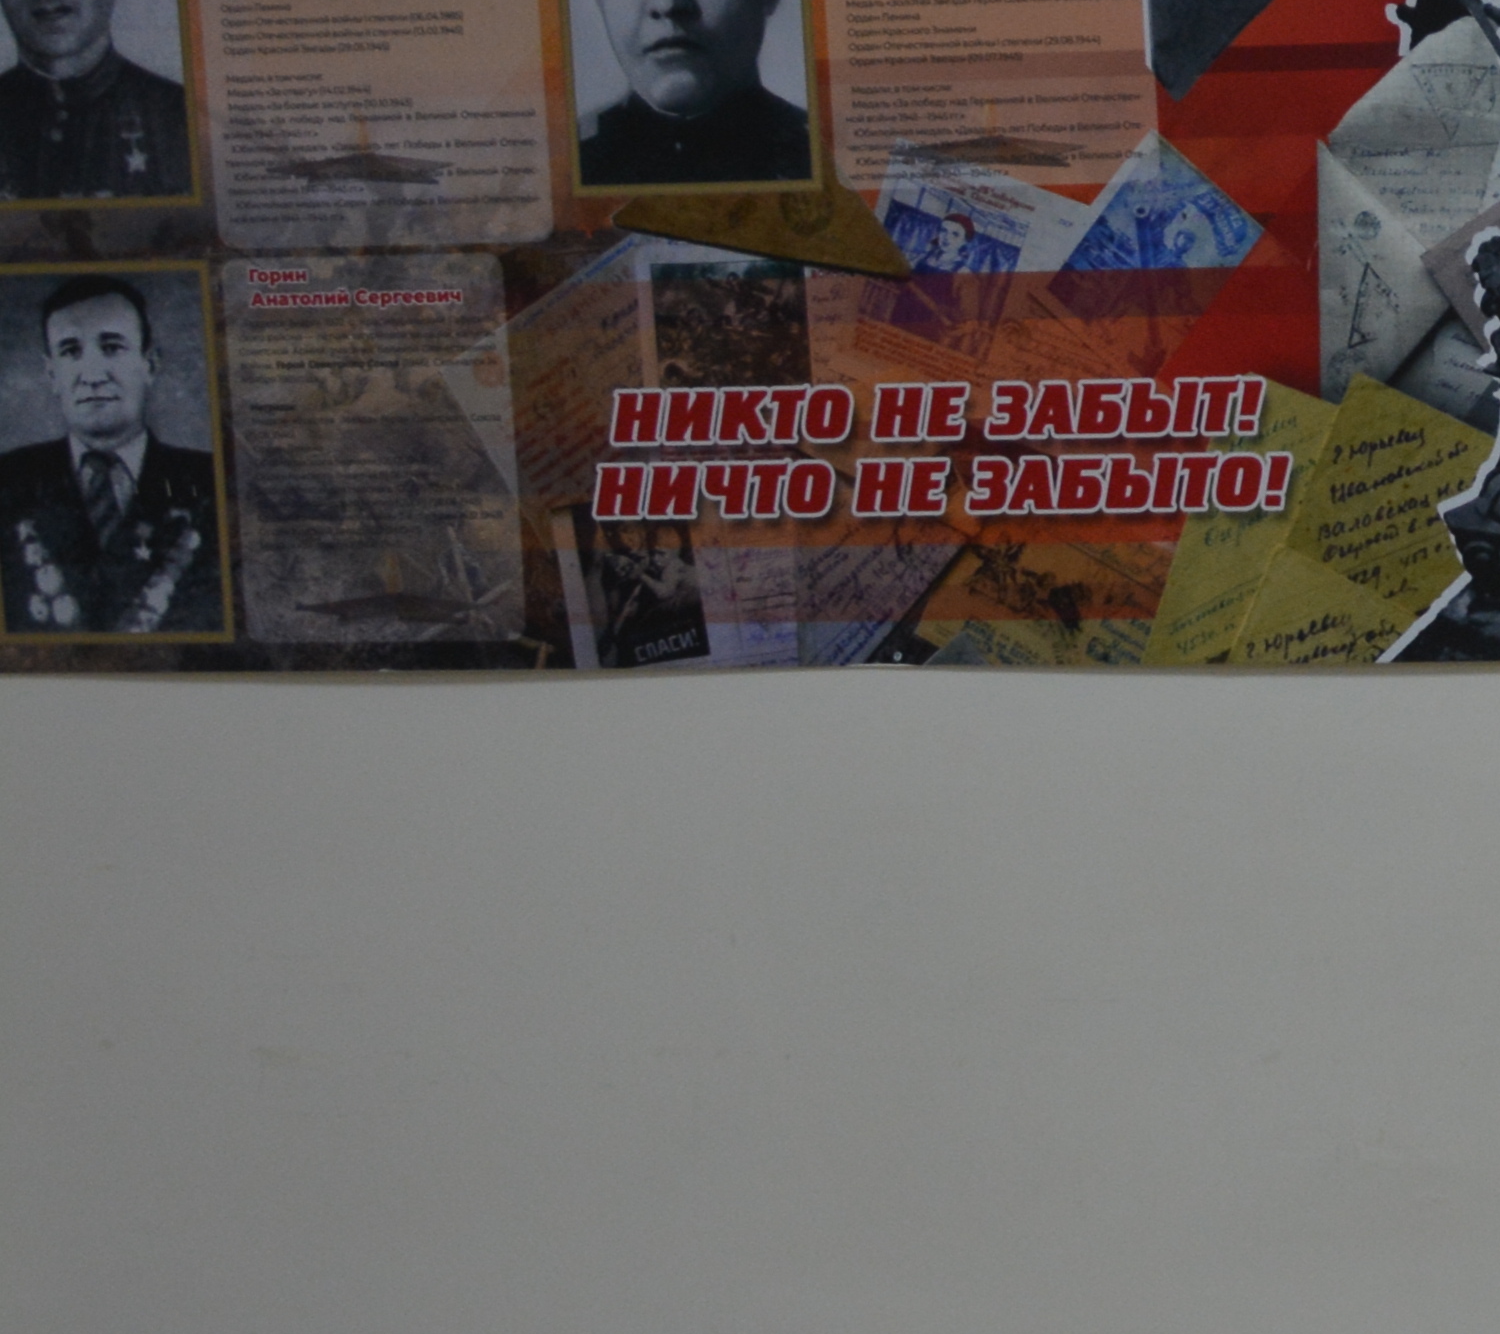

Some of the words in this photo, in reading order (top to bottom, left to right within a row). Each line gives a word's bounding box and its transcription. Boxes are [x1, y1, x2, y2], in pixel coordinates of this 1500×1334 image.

[248, 267, 308, 285] Горин
[250, 289, 350, 309] Анатолий
[354, 285, 464, 308] Сергеевич
[611, 385, 854, 447] НИКТО
[871, 382, 970, 442] НЕ
[986, 377, 1266, 439] ЗАБЫТ!
[592, 459, 836, 520] НИЧТО
[853, 455, 951, 517] НЕ
[966, 450, 1293, 514] ЗАБЫТО!
